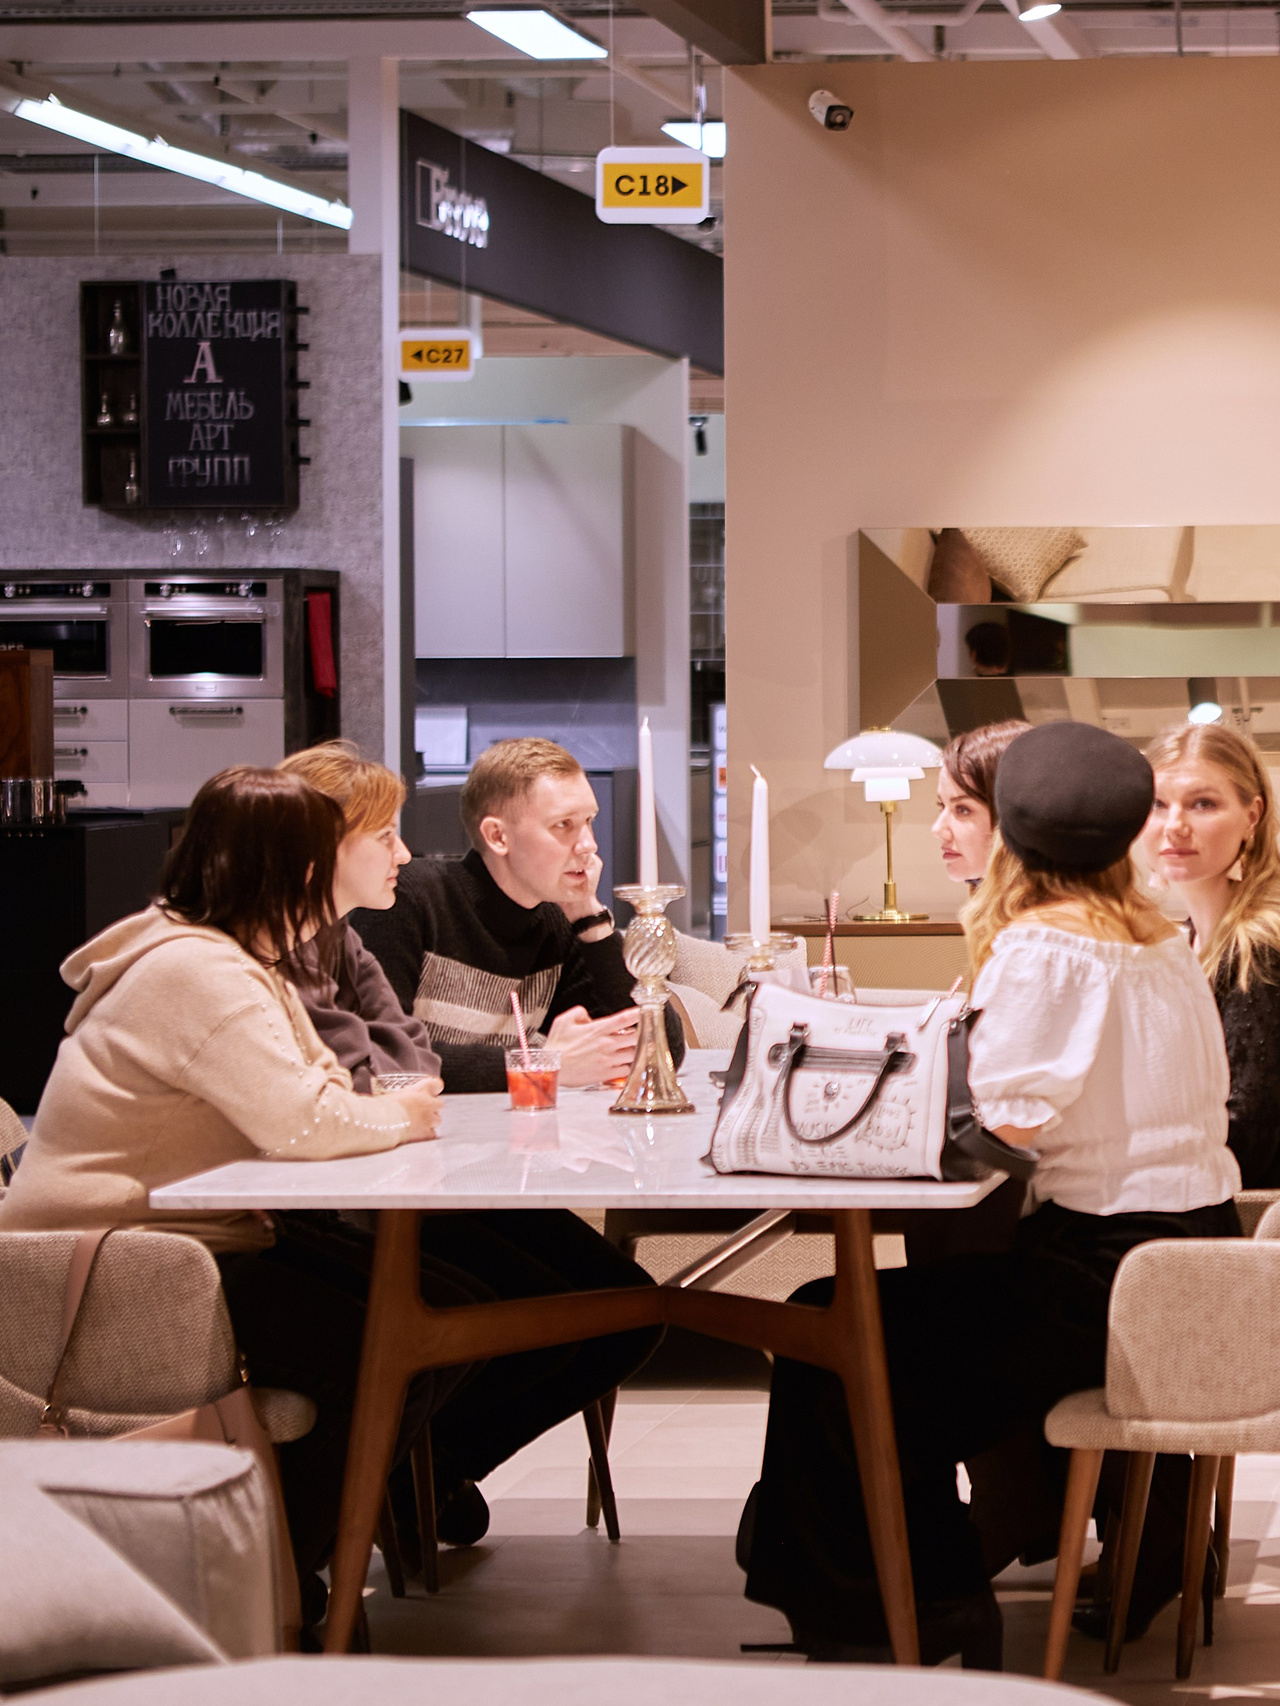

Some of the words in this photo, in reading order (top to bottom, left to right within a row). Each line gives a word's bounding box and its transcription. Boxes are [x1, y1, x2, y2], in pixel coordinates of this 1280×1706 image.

[614, 175, 669, 196] C18
[156, 284, 231, 311] НОВАЯ
[148, 311, 282, 341] КОЛЛЕКЦИЯ
[427, 348, 464, 364] C27
[165, 391, 255, 421] МЕБЕЛЬ
[189, 422, 235, 451] АРТ
[167, 456, 250, 487] ГРУПП
